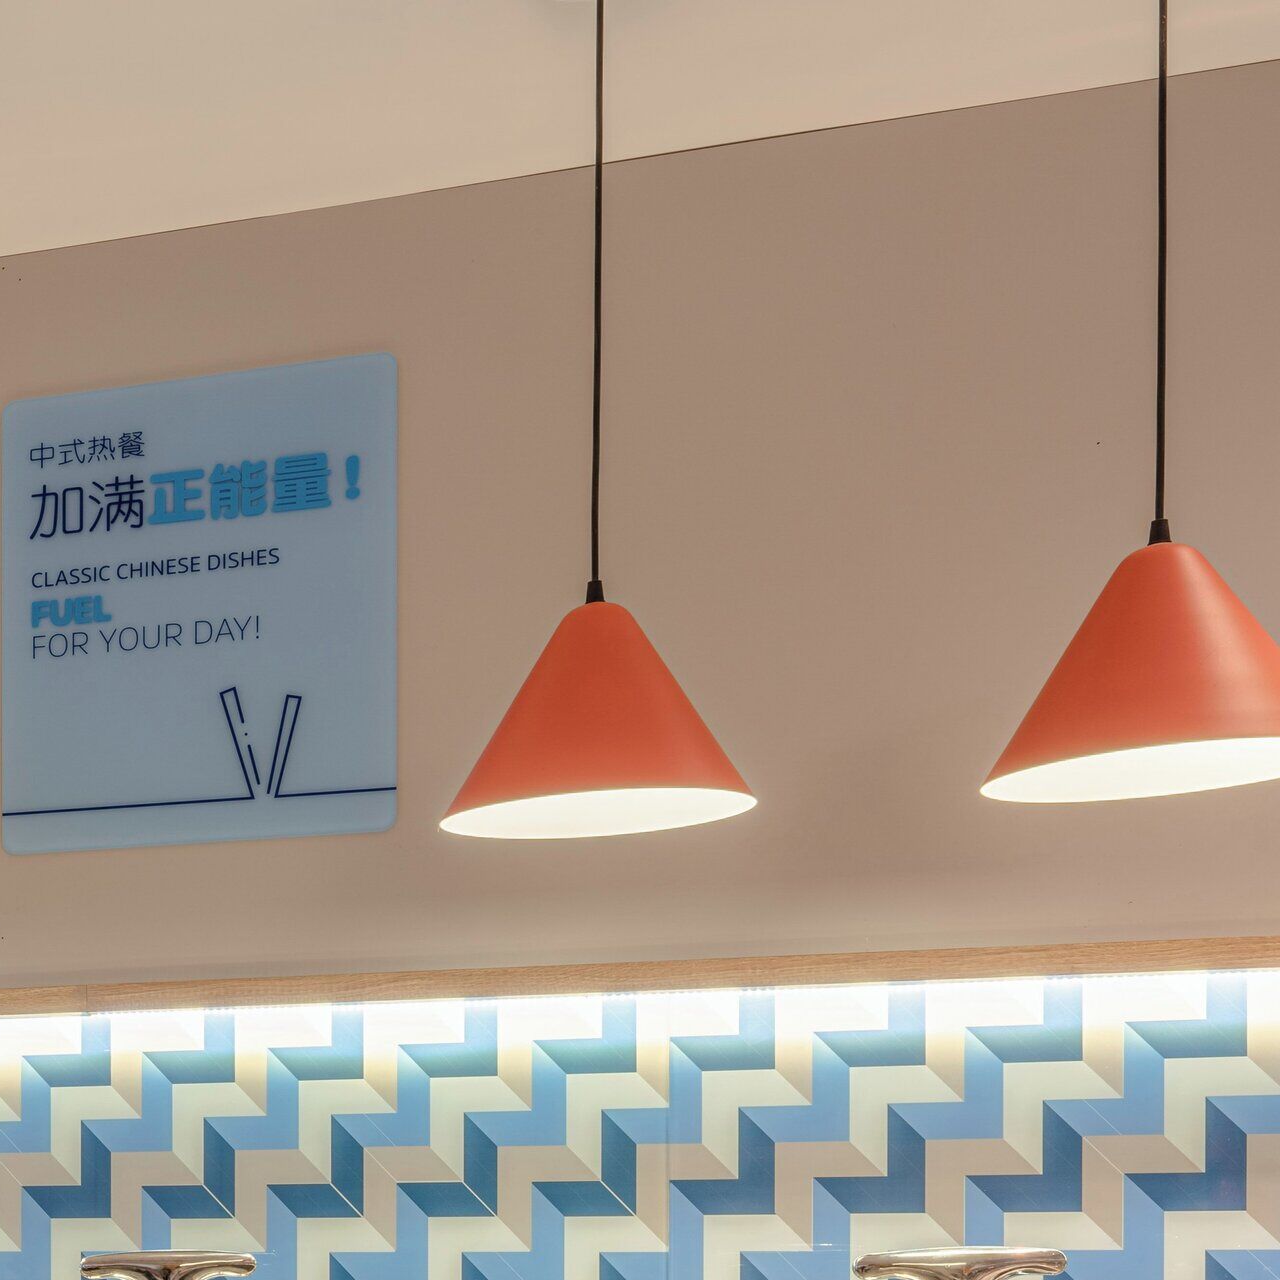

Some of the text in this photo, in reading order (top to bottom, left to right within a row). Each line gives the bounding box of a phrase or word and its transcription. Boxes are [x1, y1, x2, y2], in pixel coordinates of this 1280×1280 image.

[29, 430, 145, 469] 中式热餐
[29, 451, 361, 540] 加满正能量！
[31, 547, 280, 588] CLASSIC CHINESE DISHES
[30, 594, 112, 628] FUEL
[32, 615, 260, 660] FOR YOUR DAY!
